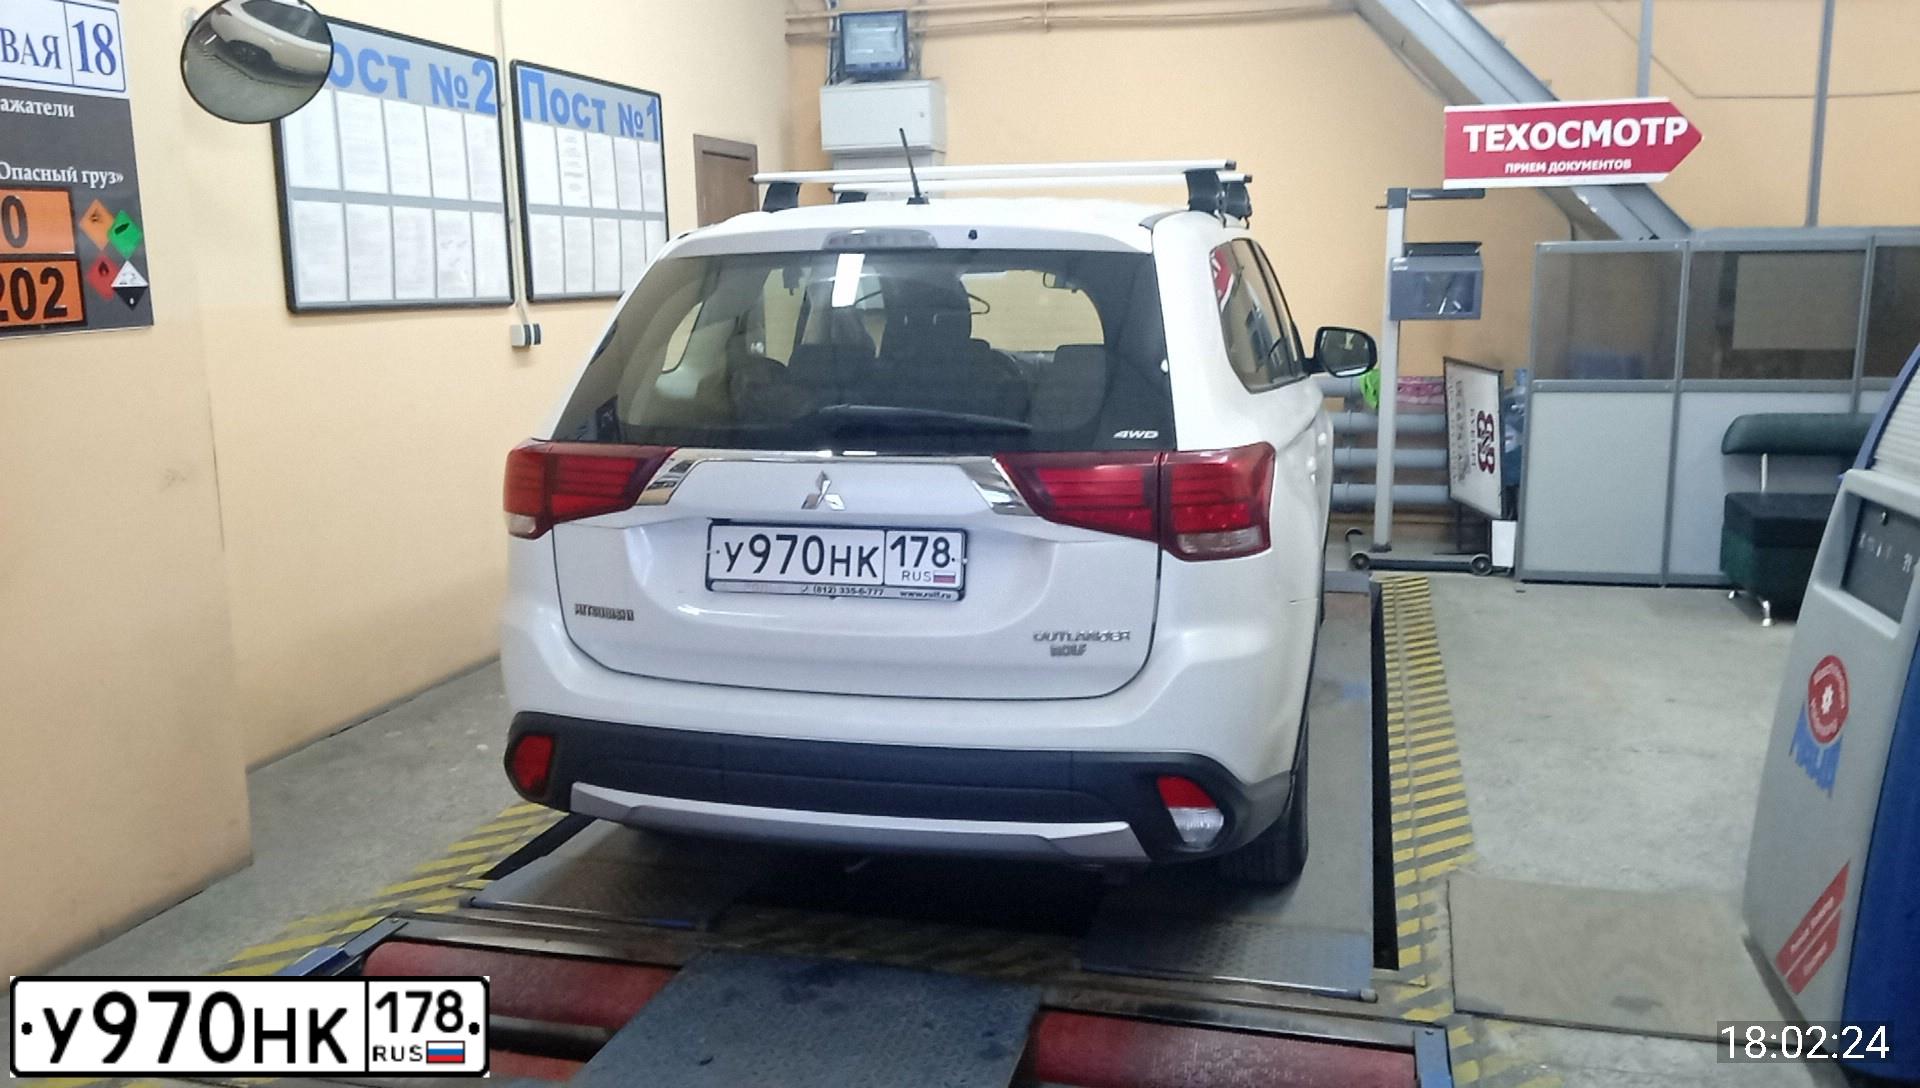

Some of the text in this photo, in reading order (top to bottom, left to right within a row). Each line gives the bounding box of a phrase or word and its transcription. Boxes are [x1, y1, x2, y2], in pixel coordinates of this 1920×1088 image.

[0, 20, 117, 76] ВАЯ 18
[329, 42, 410, 99] ост
[0, 98, 75, 118] ажатели
[1463, 115, 1689, 153] ТЕХОСМОТР
[0, 161, 124, 189] Опасный груз»
[1504, 158, 1632, 175] ПРИЕМ ДОКУМЕНТОВ
[1112, 430, 1159, 439] 4WD
[724, 533, 951, 578] У970НК 178
[902, 570, 932, 582] RUS
[813, 584, 837, 594] (812)
